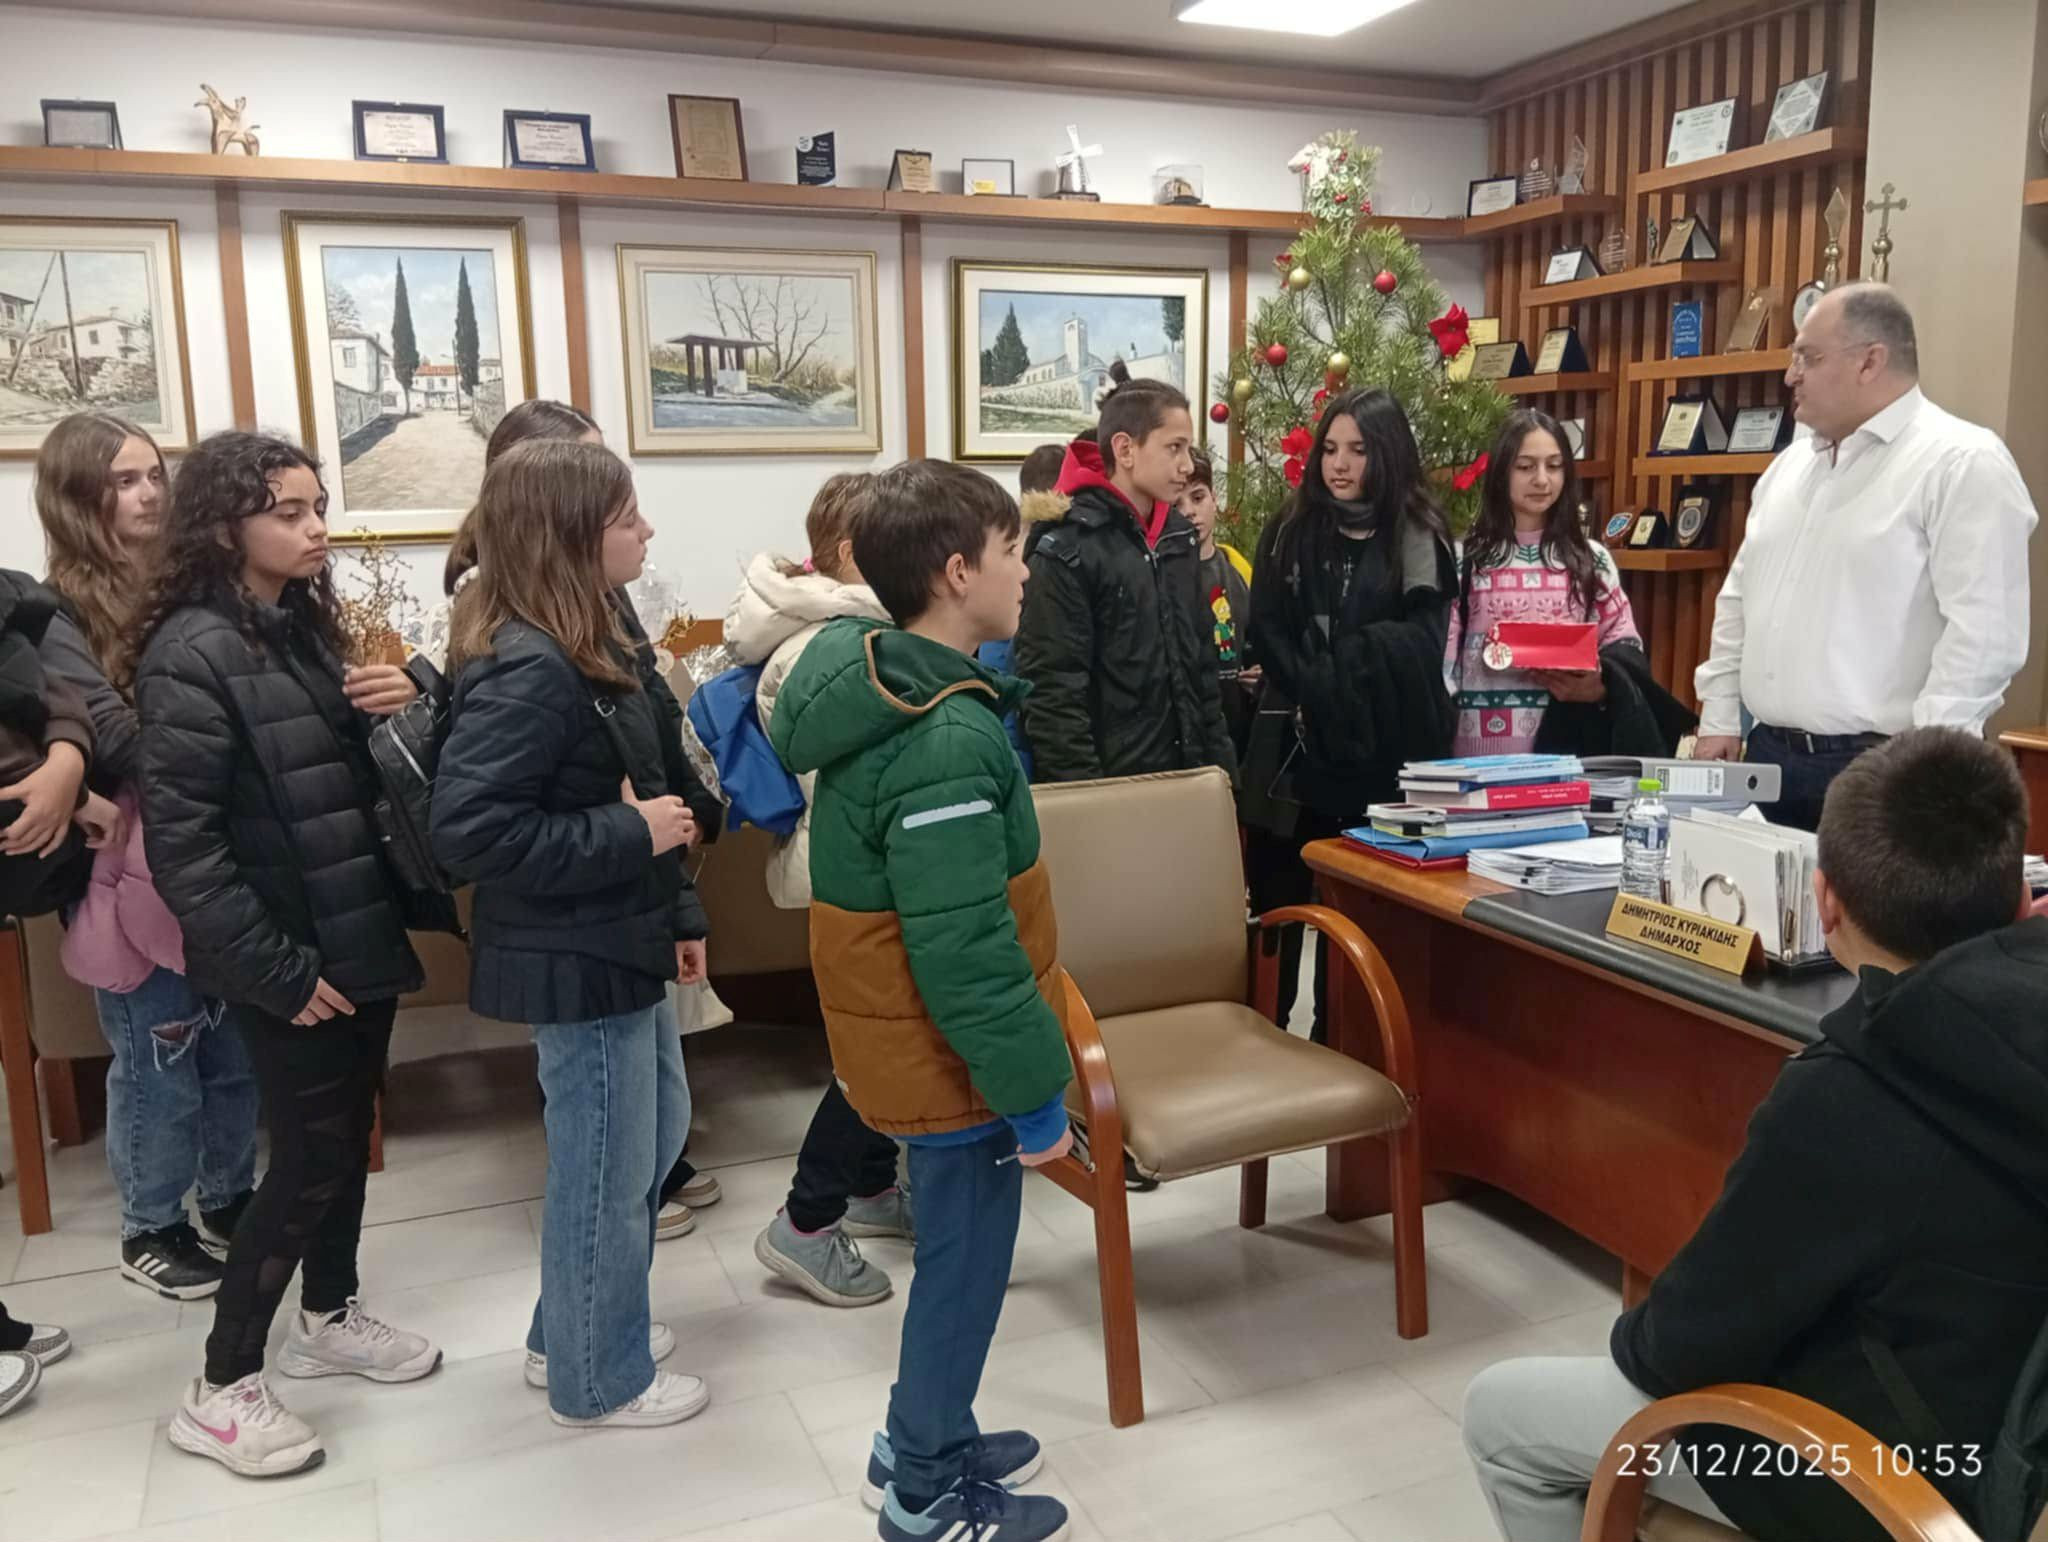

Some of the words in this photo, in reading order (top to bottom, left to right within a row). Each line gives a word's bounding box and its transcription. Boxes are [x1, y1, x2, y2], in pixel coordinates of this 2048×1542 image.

[1621, 903, 1677, 928] ΔΗΜΗΤΡΙΟΣ
[1678, 919, 1739, 947] ΚΥΡΙΑΚΙΔΗΣ
[1640, 926, 1702, 954] ΔΗΜΑΡΧΟΣ
